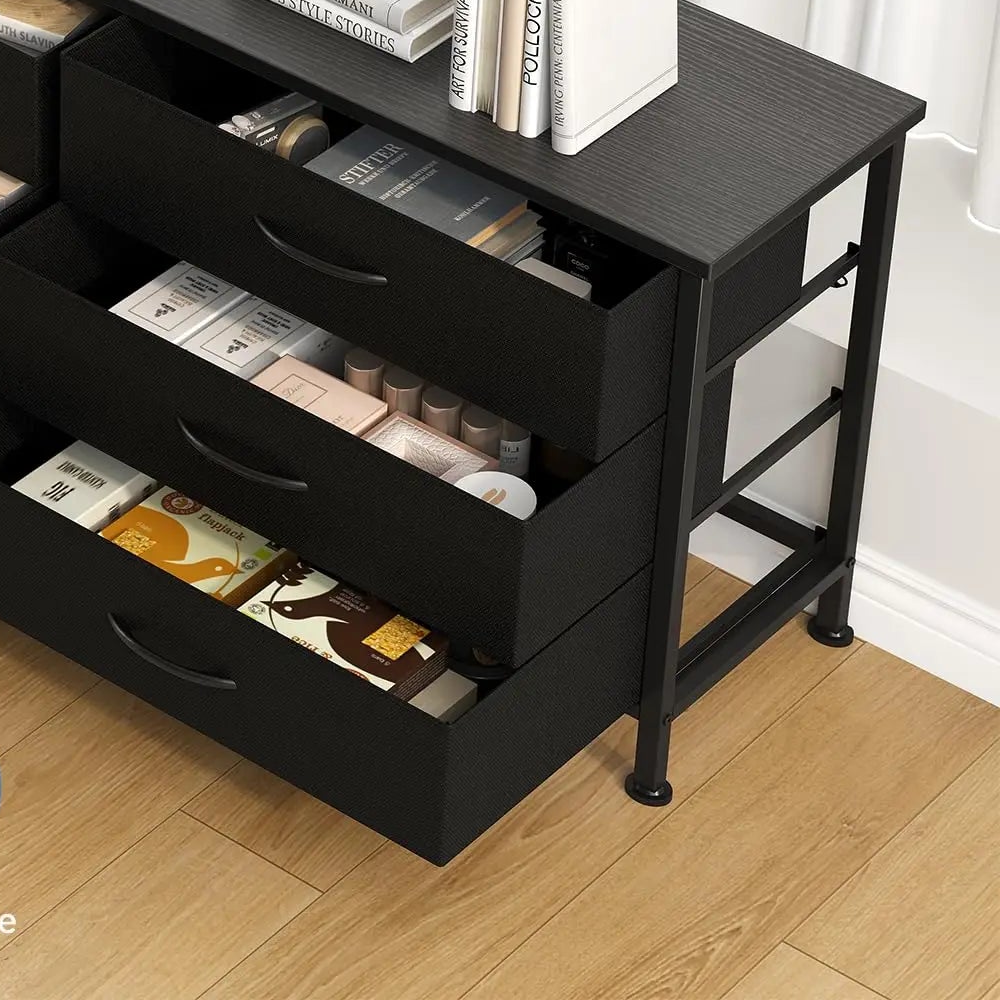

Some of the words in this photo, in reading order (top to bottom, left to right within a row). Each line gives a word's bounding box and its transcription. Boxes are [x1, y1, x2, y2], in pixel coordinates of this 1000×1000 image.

[335, 14, 395, 53] STORIES
[452, 46, 467, 74] FOR
[553, 58, 565, 88] PENN:
[450, 73, 465, 100] ART
[553, 89, 565, 127] IRVING
[338, 143, 404, 185] STIFTER
[197, 512, 247, 542] flapjack
